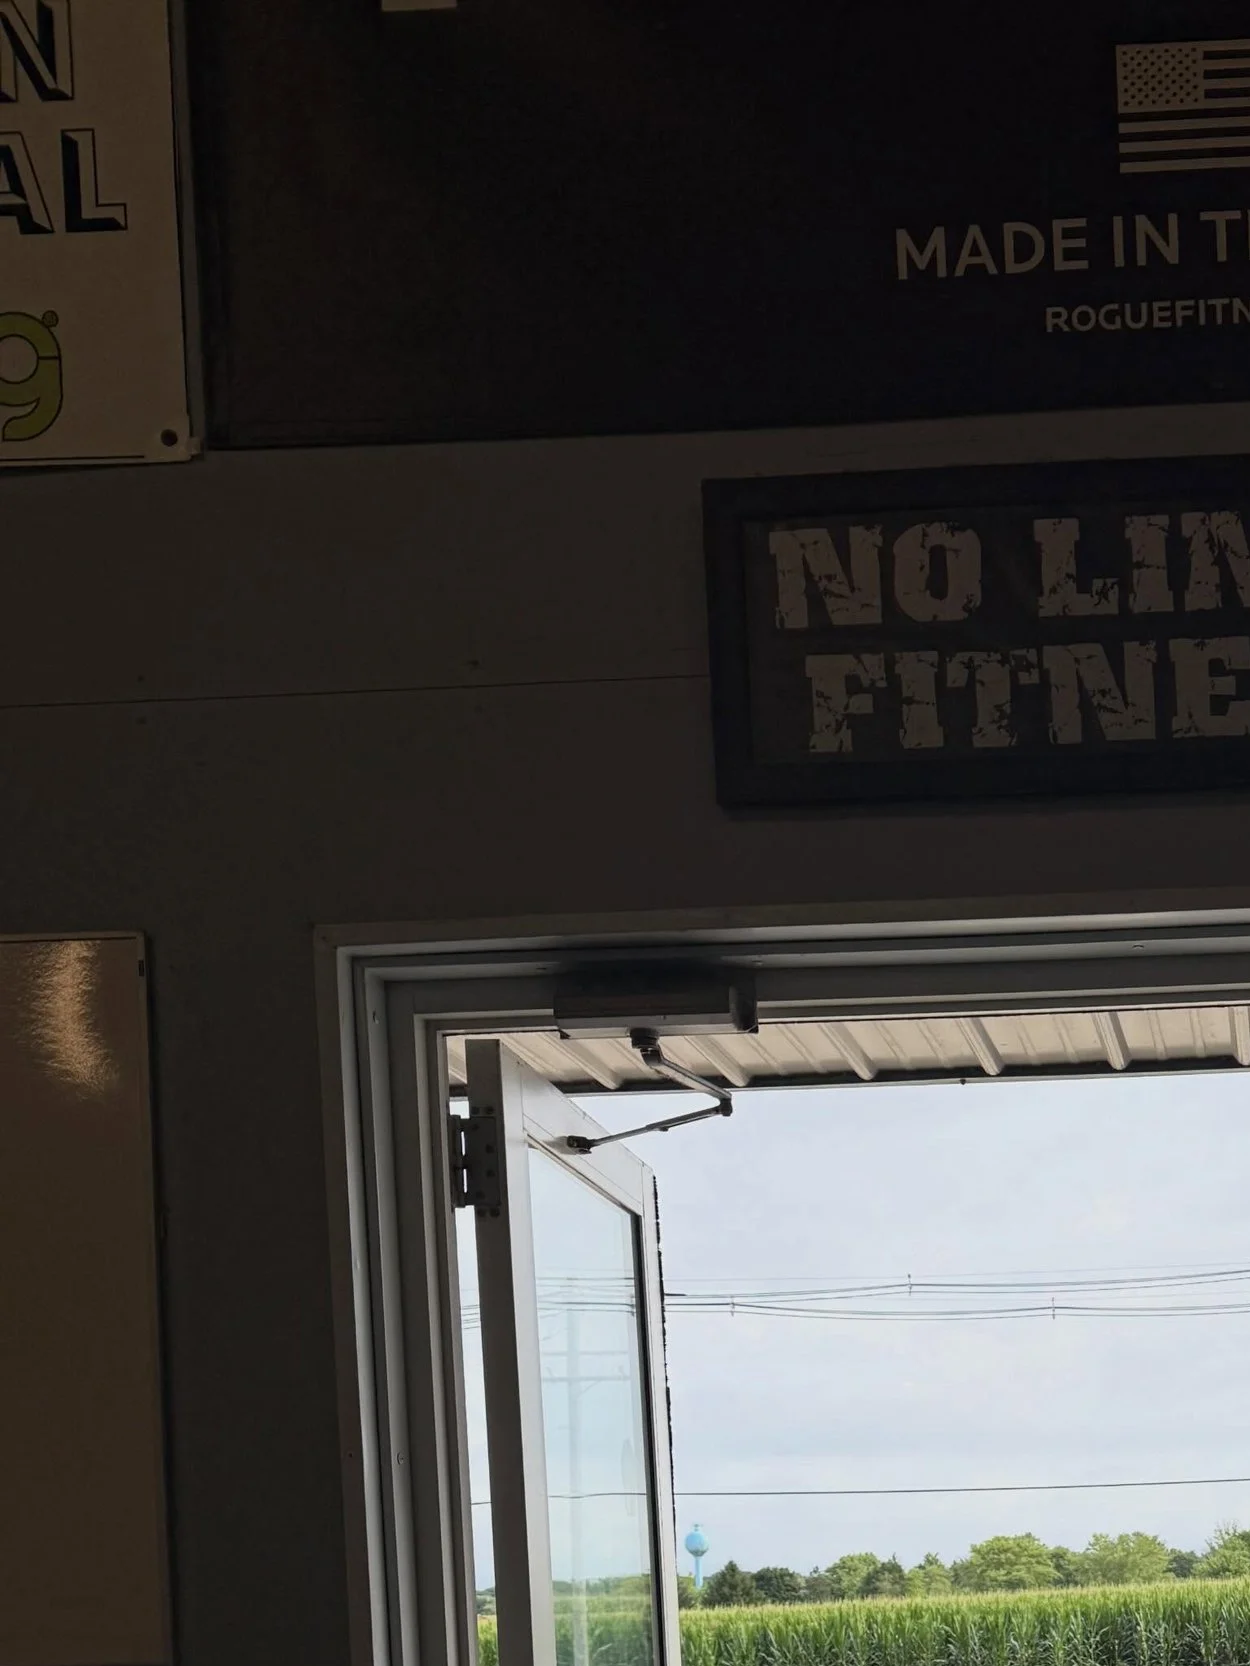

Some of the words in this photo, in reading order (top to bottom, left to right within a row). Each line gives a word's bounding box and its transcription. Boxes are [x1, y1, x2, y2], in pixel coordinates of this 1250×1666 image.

[894, 217, 1090, 281] MADE
[1111, 212, 1181, 268] IN
[768, 520, 984, 630] NO
